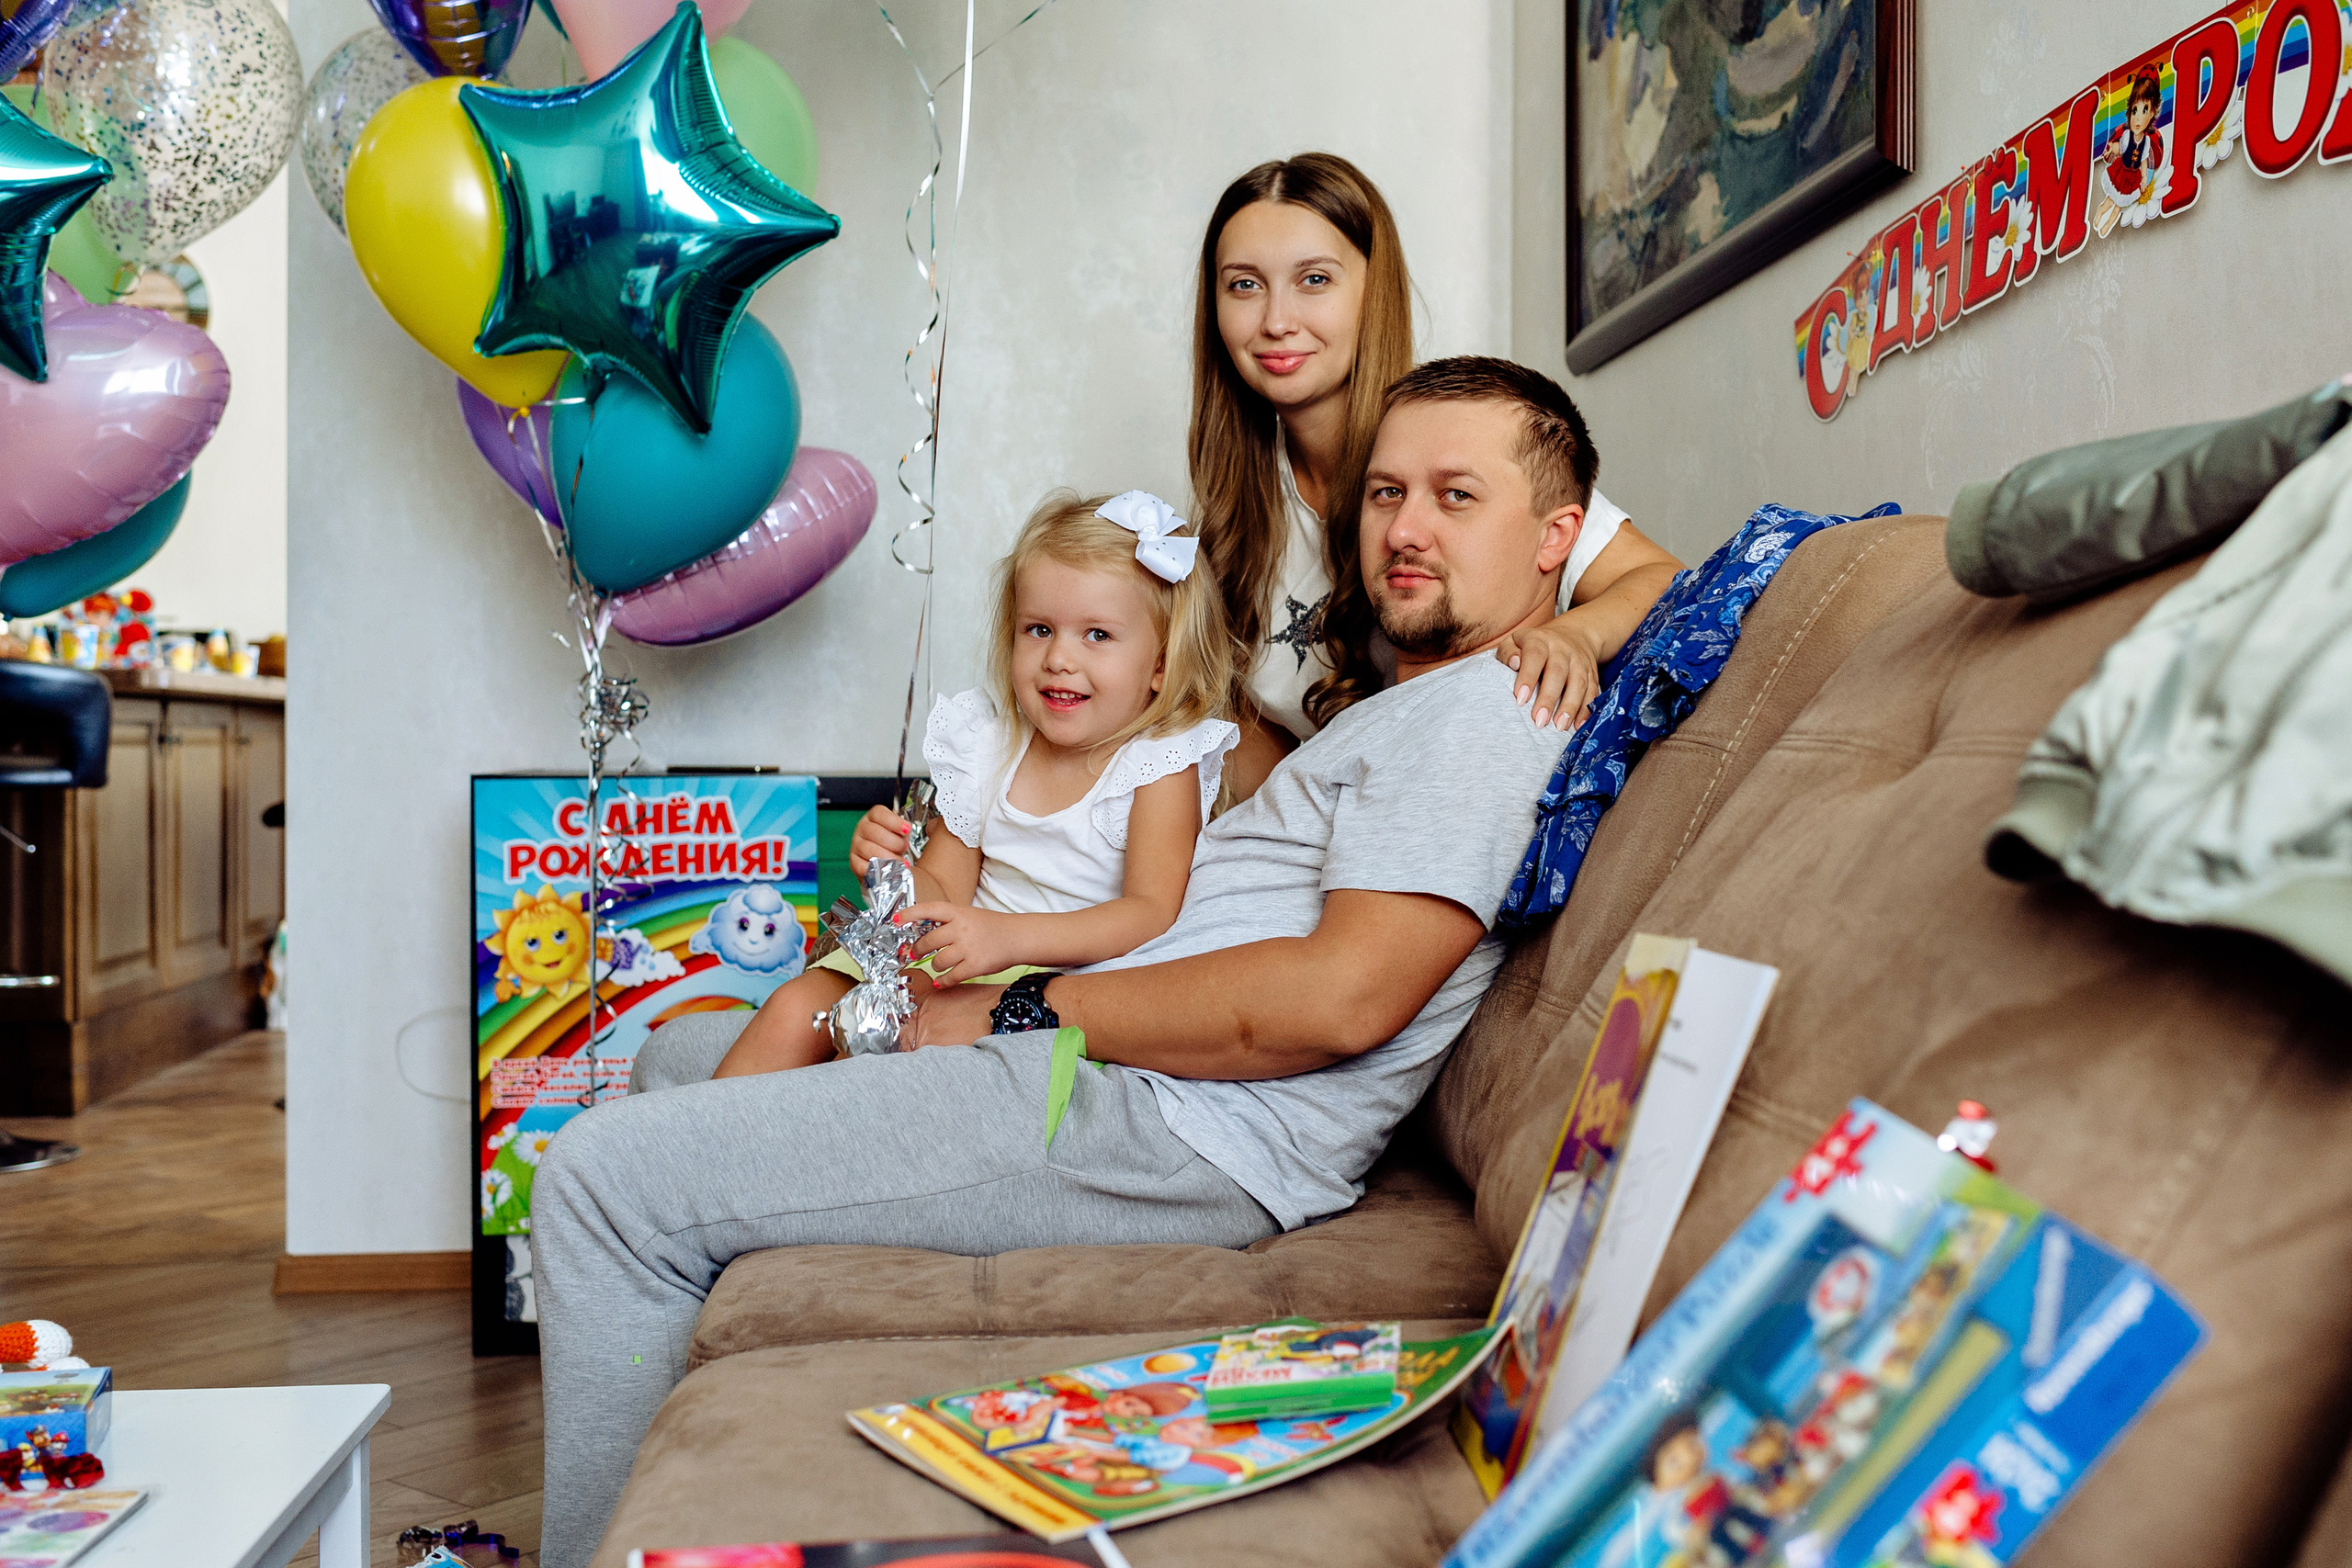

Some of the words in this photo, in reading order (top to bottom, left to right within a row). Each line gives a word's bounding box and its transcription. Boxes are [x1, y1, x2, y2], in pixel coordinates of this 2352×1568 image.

[1805, 288, 1848, 421] С
[1868, 86, 2100, 375] ДНЁМ
[2162, 0, 2352, 217] РО
[559, 802, 585, 837] С
[599, 795, 734, 838] ДНЁМ
[509, 840, 786, 880] РОЖДЕНИЯ!
